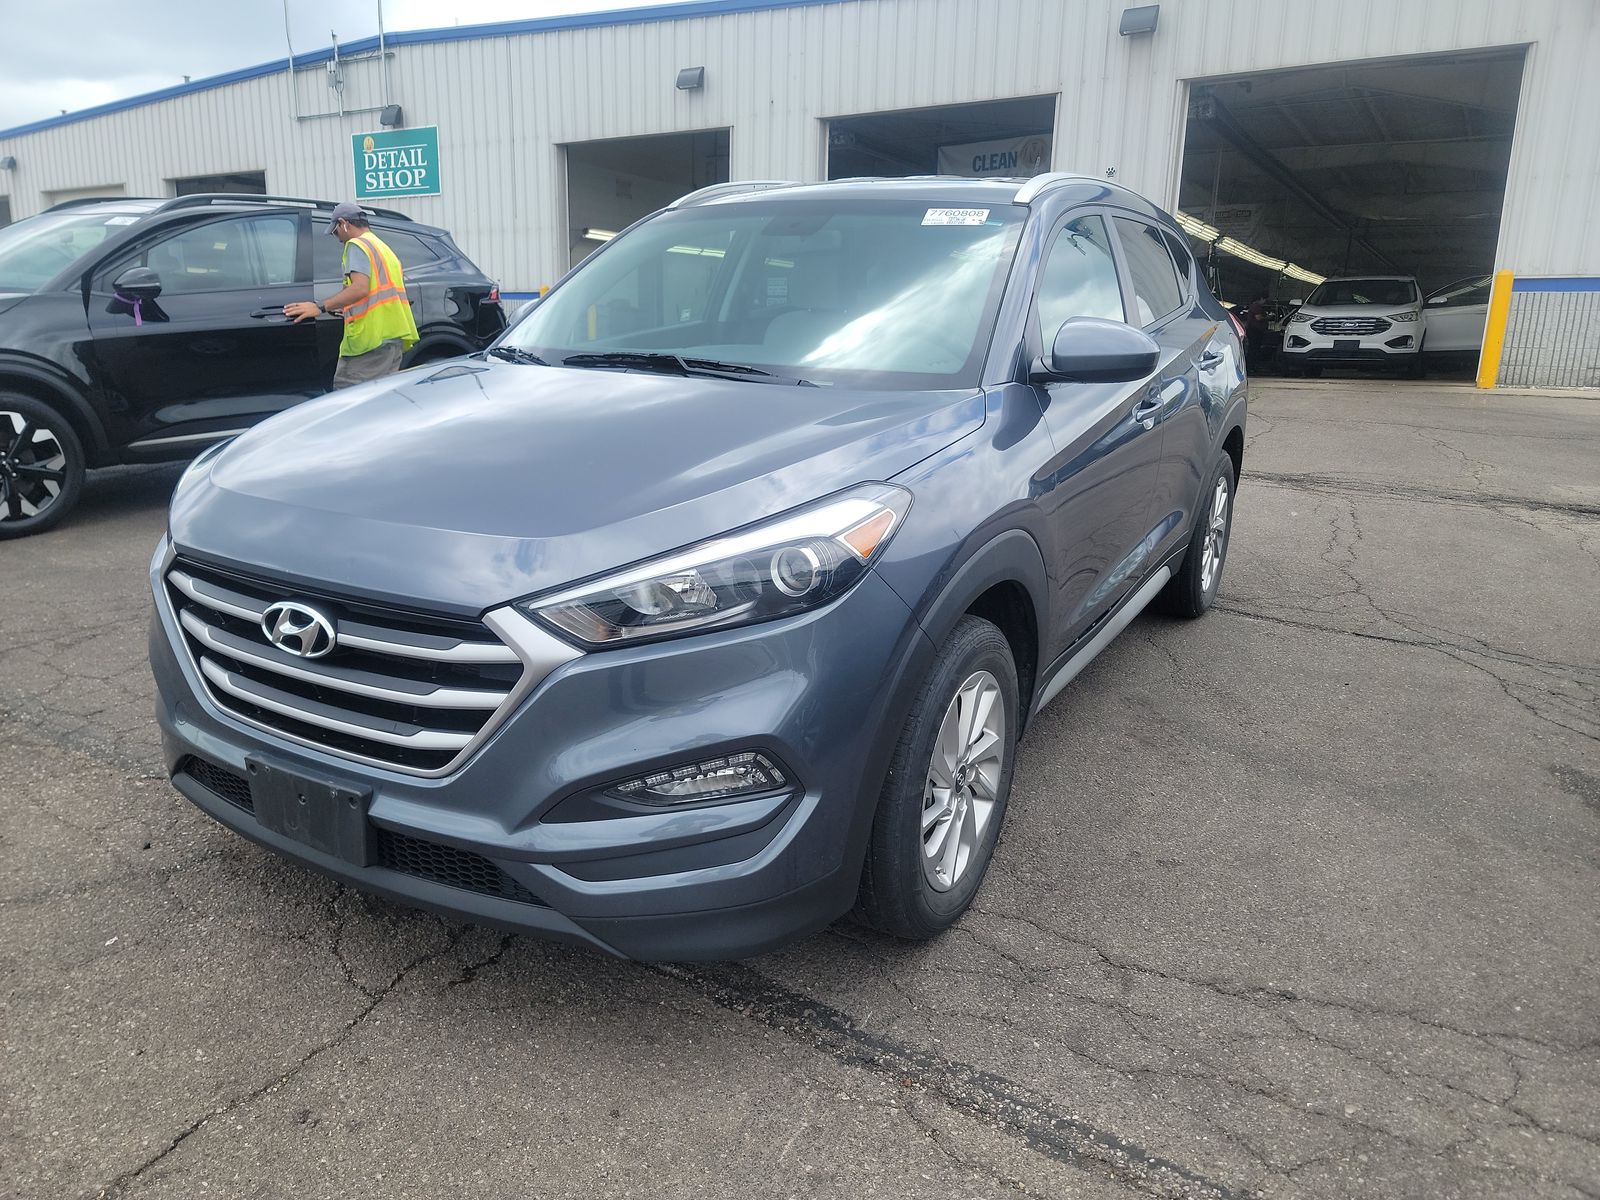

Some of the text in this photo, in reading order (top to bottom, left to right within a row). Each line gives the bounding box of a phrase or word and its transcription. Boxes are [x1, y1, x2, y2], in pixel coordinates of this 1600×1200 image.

[364, 148, 428, 170] DETAIL
[972, 151, 1018, 172] CLEAN
[365, 169, 426, 189] SHOP
[930, 209, 984, 217] 7760808
